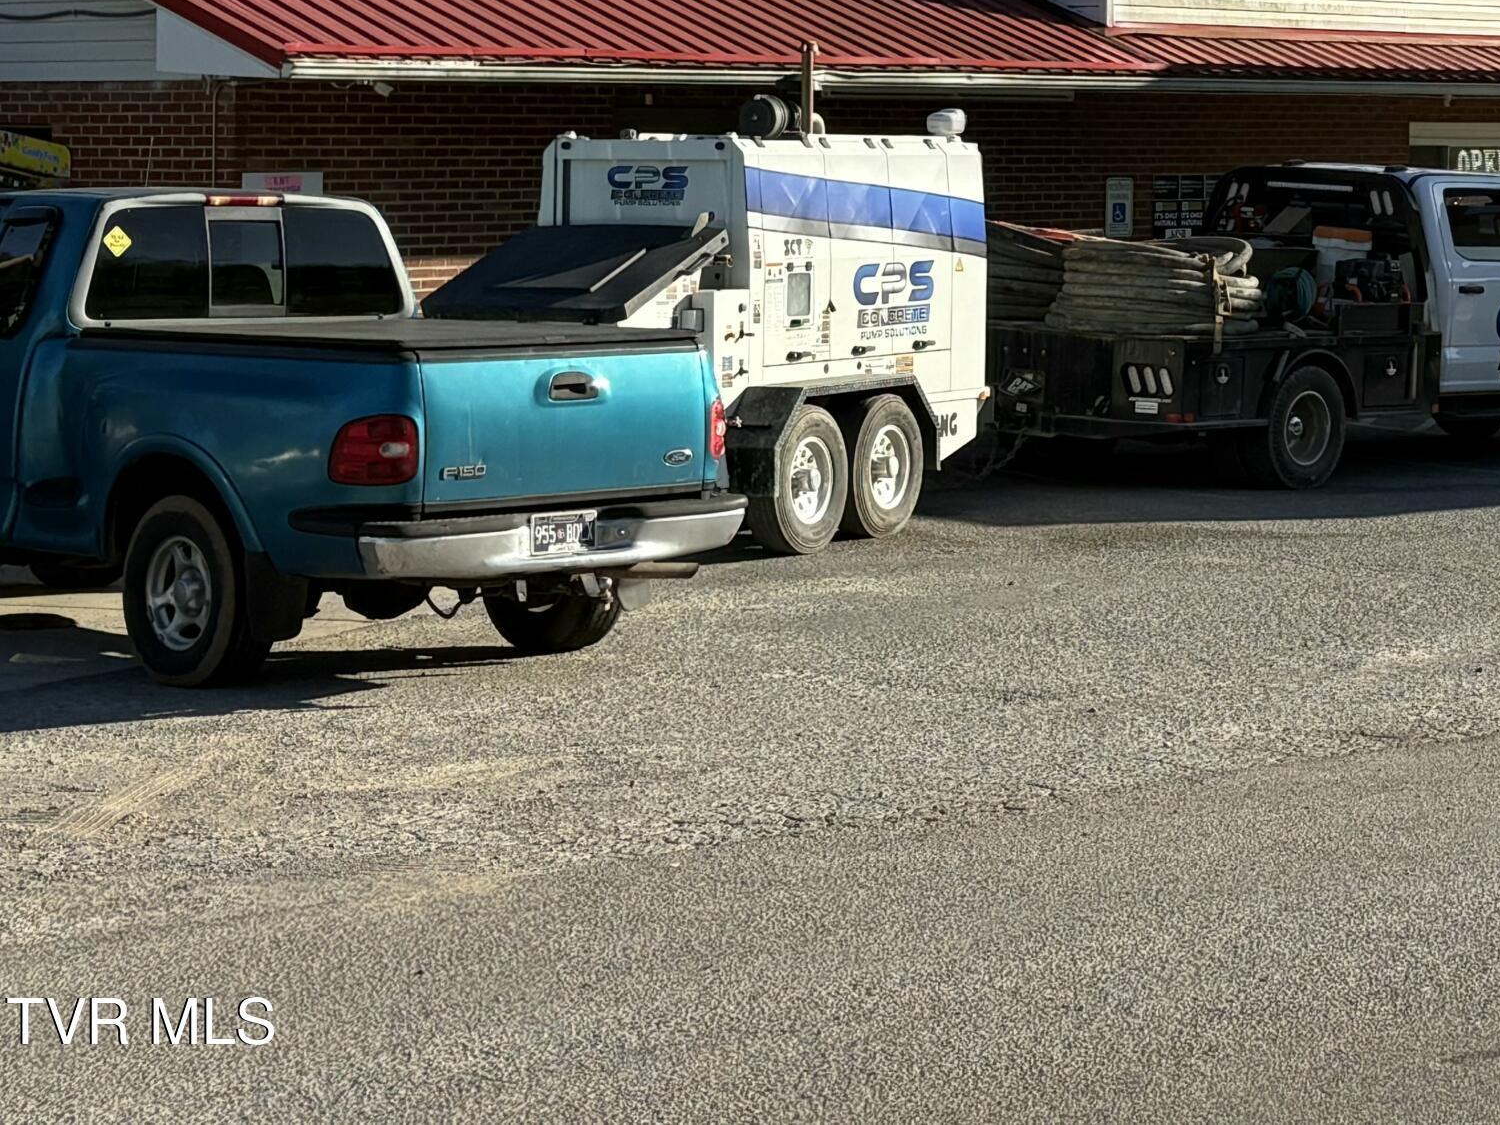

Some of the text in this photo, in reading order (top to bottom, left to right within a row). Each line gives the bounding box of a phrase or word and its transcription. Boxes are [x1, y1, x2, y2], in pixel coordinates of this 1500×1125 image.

[607, 165, 689, 189] CPS
[853, 259, 935, 306] CPS
[859, 306, 929, 327] CONCRETE
[860, 325, 928, 340] PUMP SOLUTIONS
[1007, 377, 1035, 394] CAT
[443, 464, 488, 480] F150
[535, 524, 557, 545] 955
